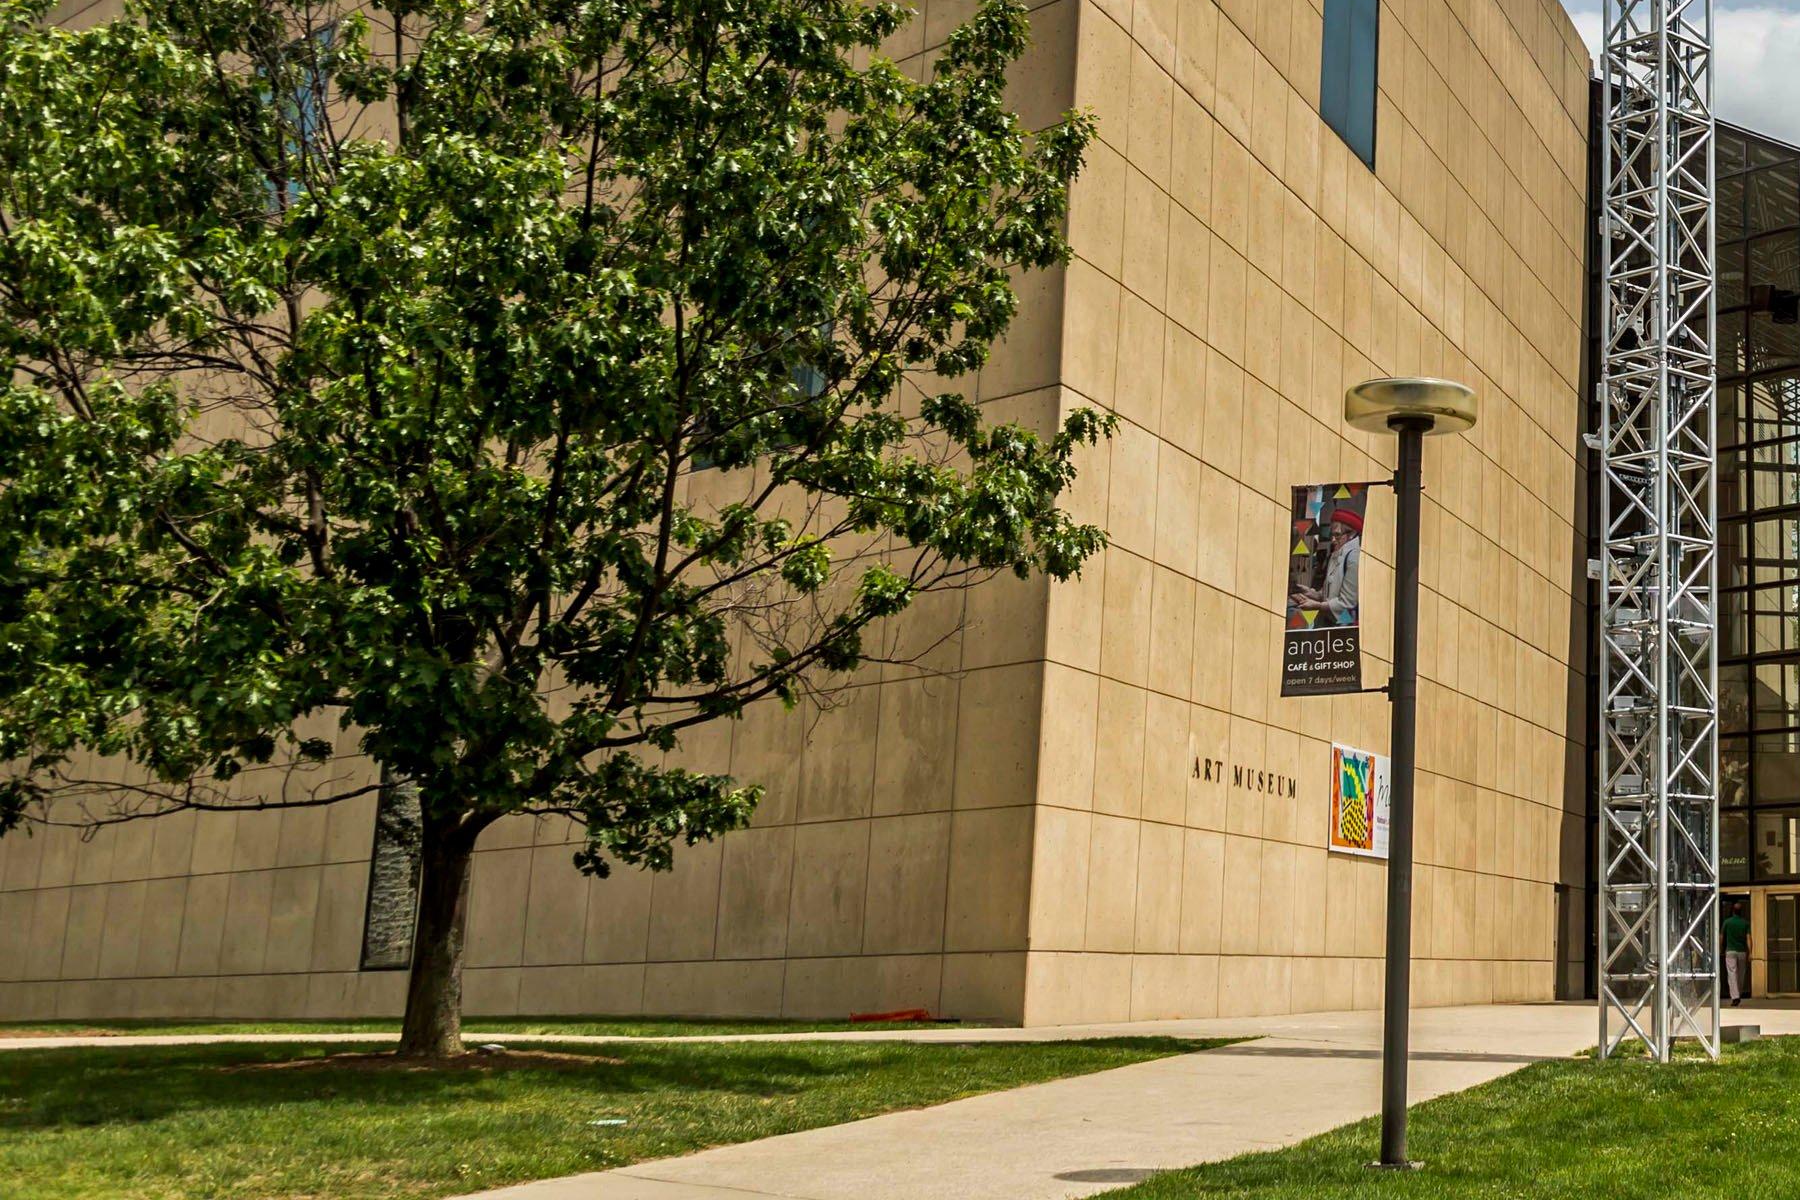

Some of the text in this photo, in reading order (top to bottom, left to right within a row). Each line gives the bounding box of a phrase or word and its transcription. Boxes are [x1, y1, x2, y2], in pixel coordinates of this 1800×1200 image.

[1288, 631, 1355, 660] angles
[1287, 662, 1308, 671] CAFÉ
[1314, 662, 1332, 670] GIFT
[1333, 661, 1355, 669] SHOP
[1192, 756, 1296, 800] ART MUSEUM
